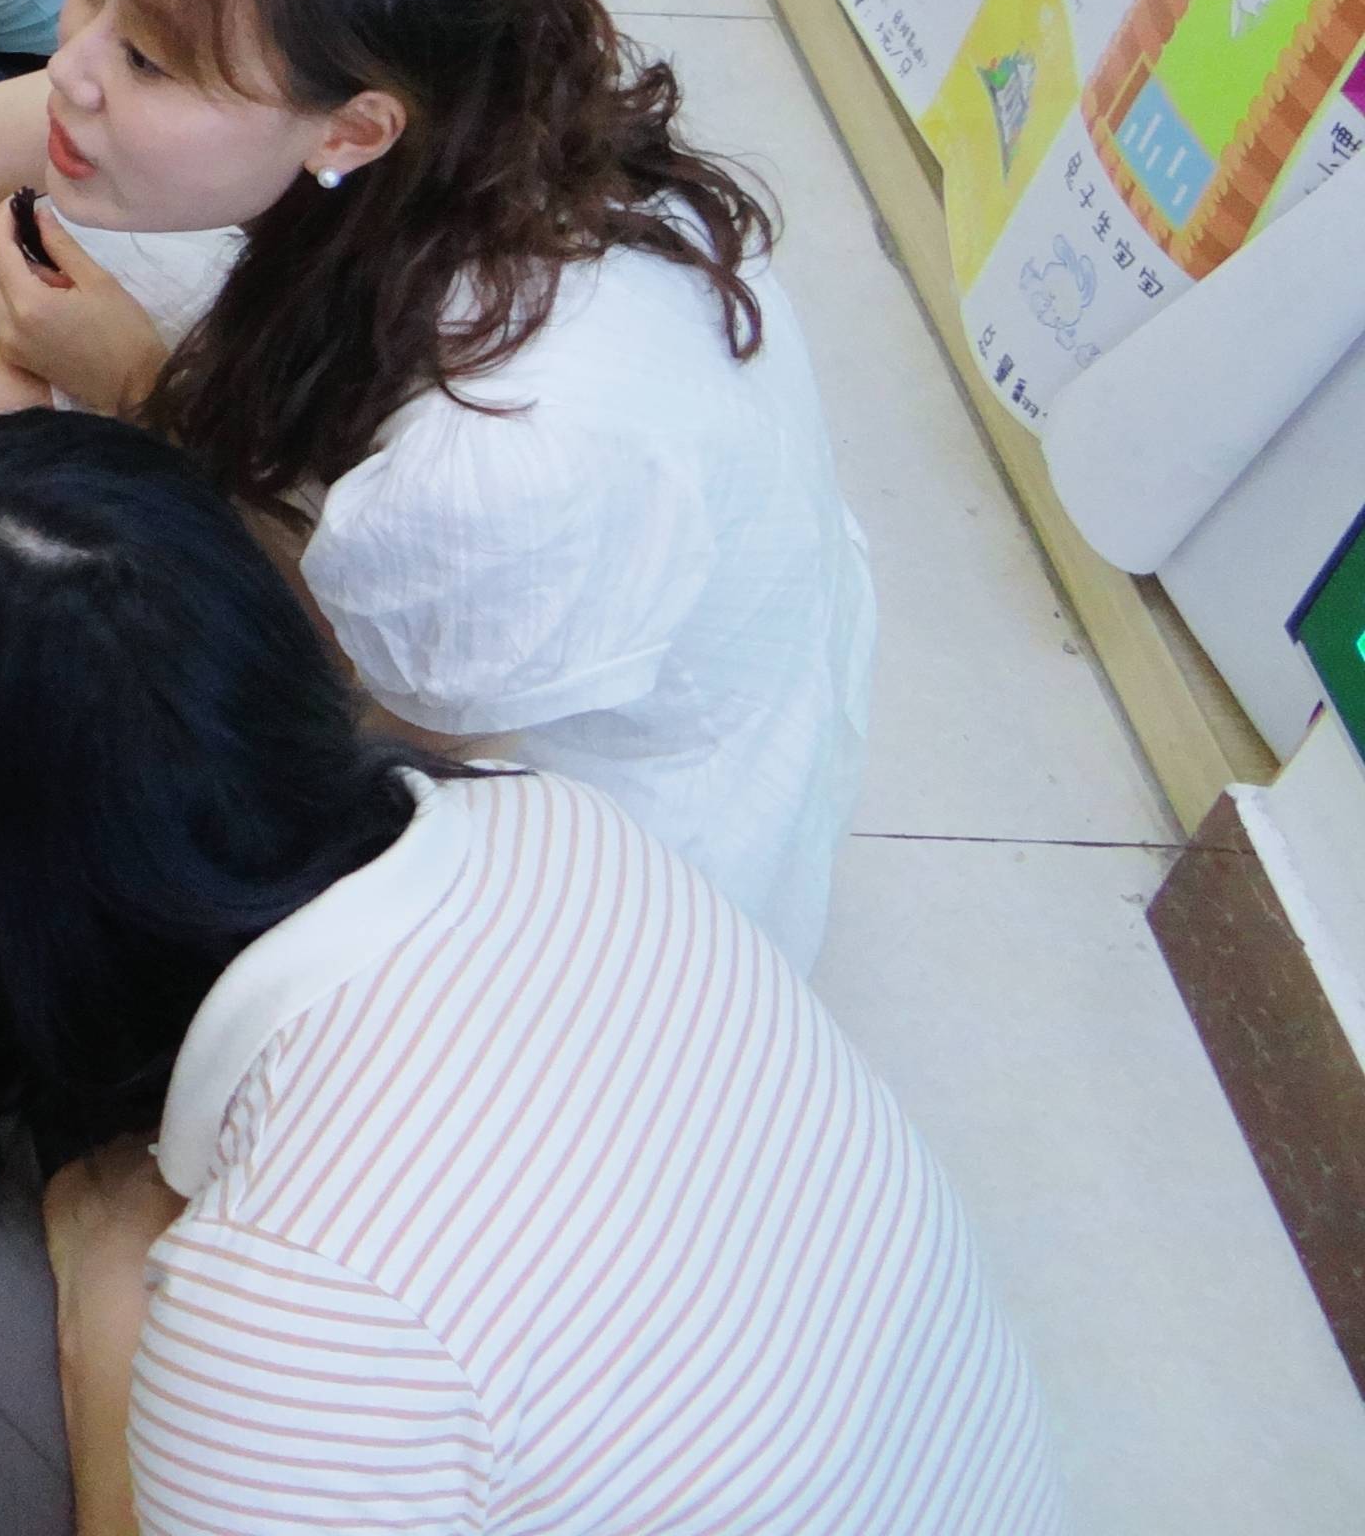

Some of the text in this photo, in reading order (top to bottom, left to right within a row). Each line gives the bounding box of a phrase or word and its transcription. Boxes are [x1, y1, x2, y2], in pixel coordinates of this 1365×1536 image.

[1065, 152, 1165, 300] 兔子生宝宝
